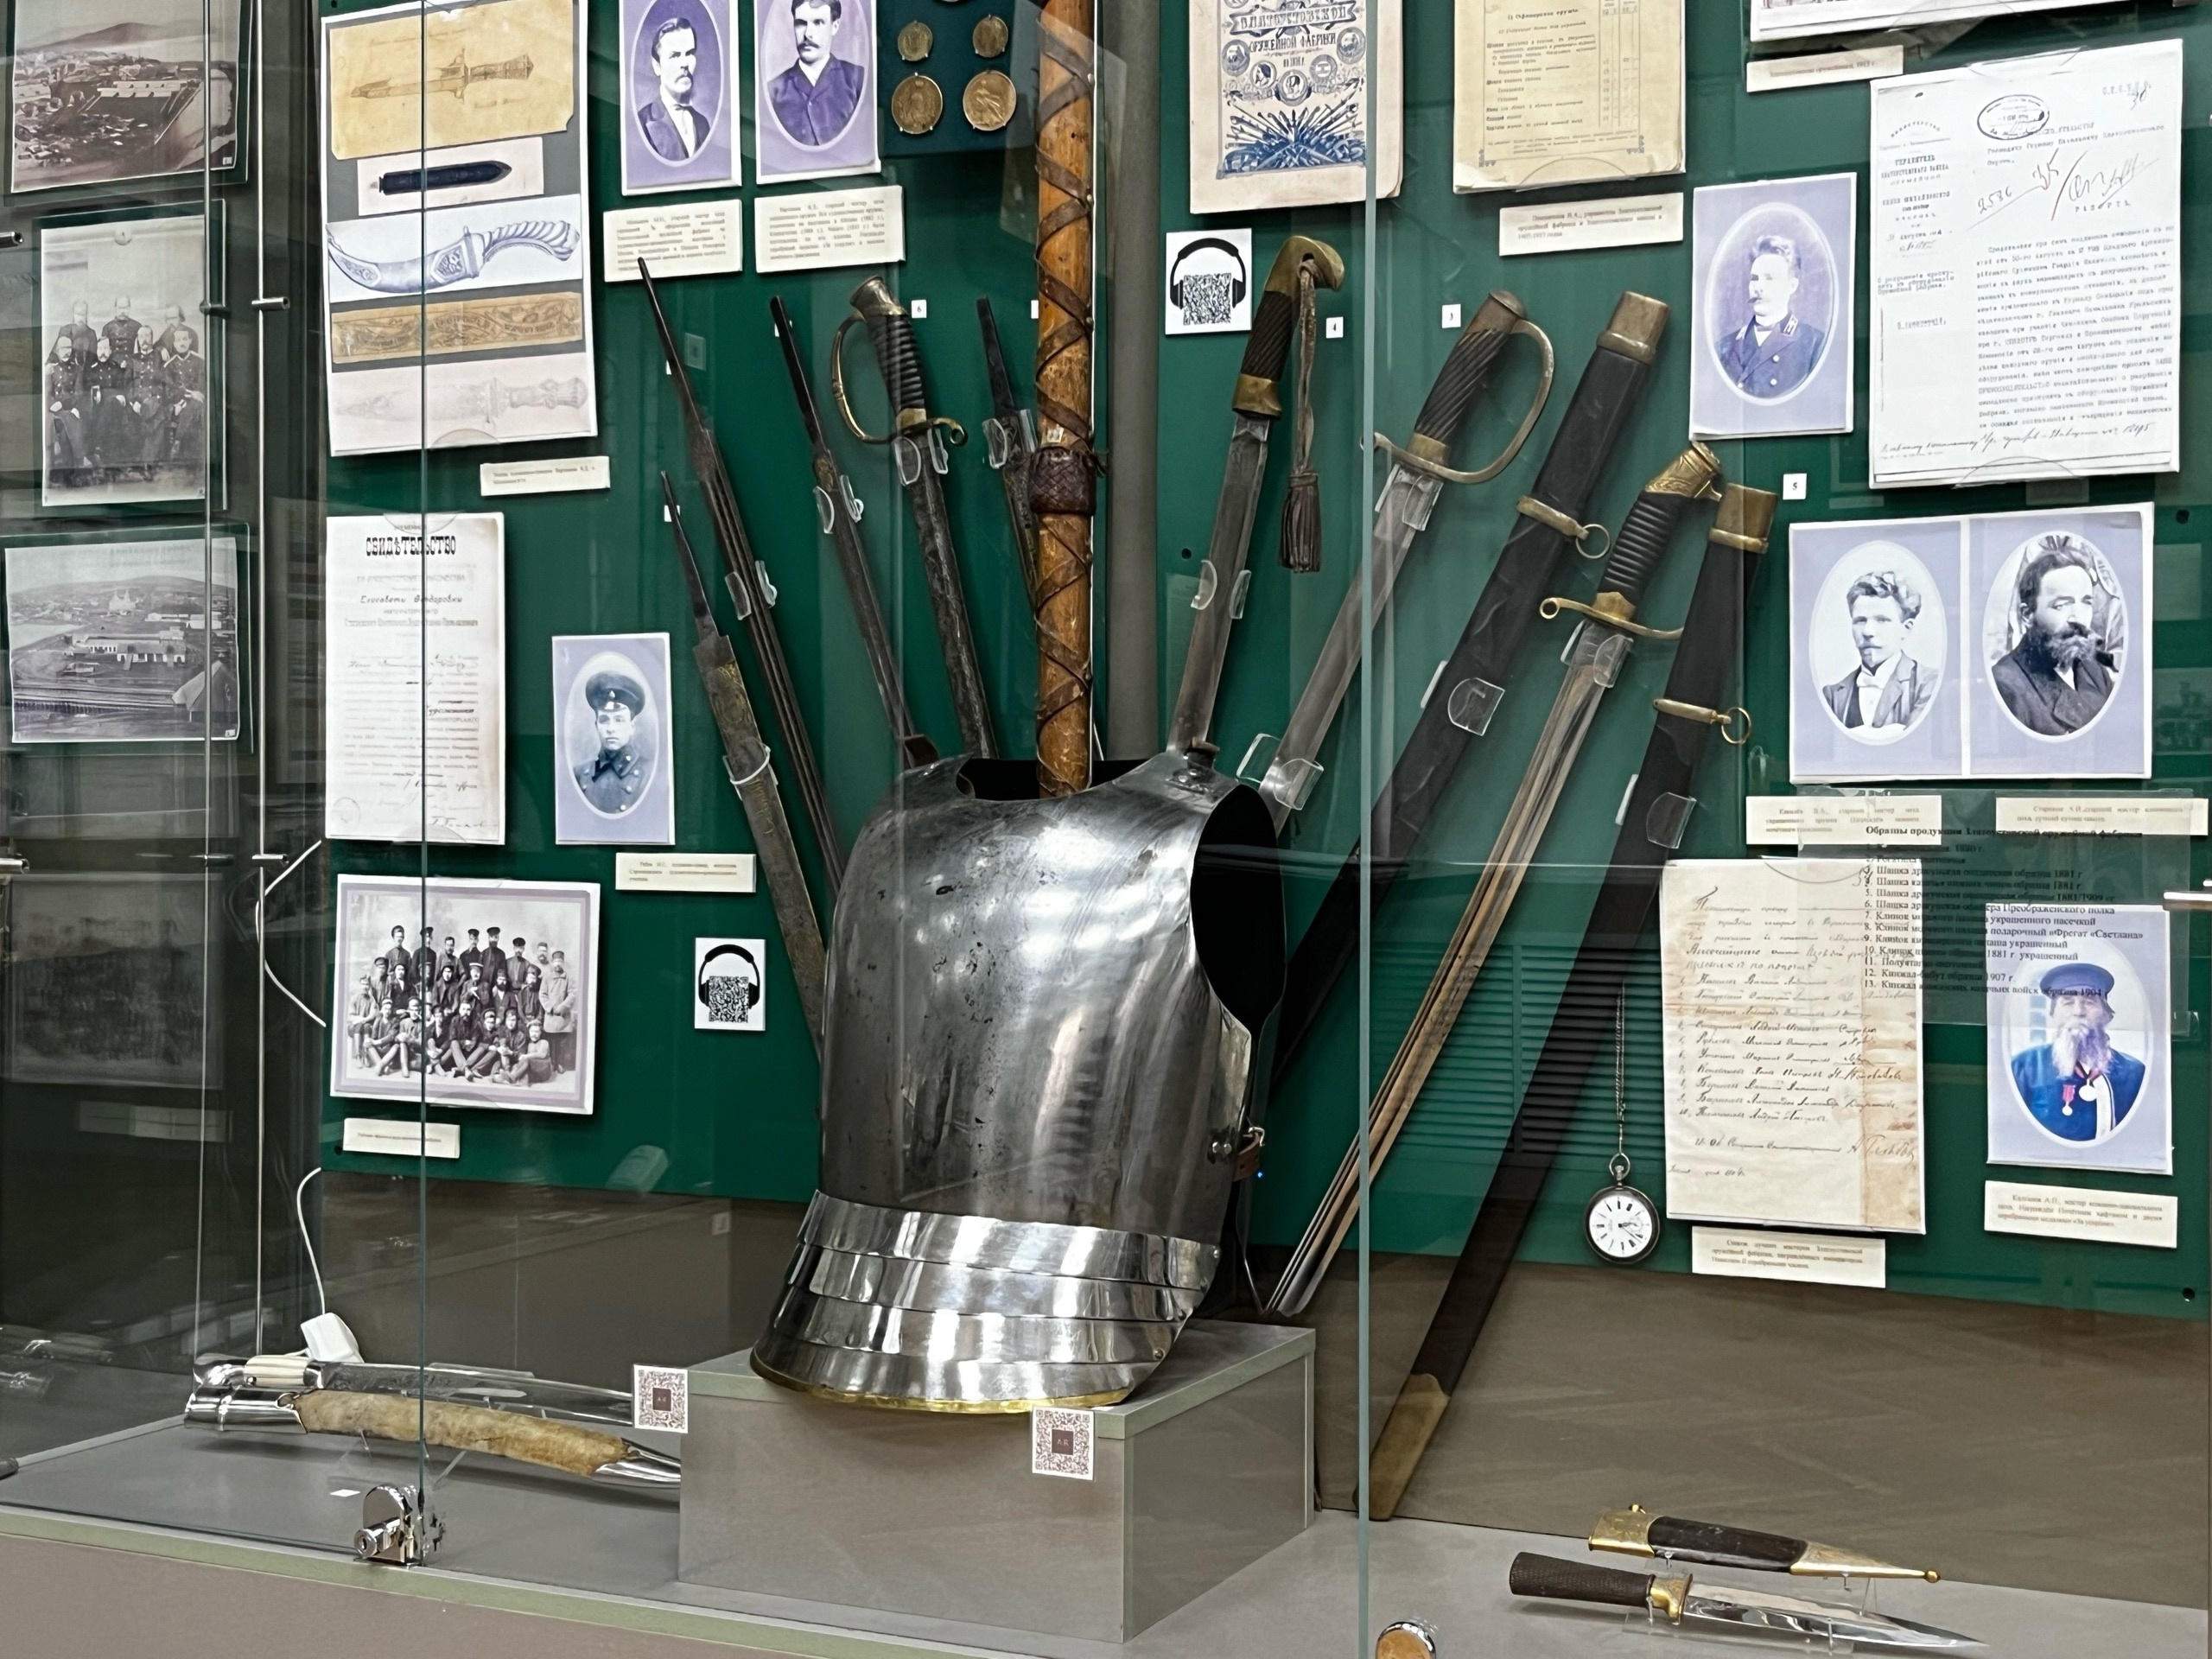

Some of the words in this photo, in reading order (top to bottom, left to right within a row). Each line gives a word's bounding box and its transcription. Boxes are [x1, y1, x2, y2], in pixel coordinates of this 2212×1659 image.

[1791, 481, 1798, 491] 5
[1877, 866, 1909, 875] Шашка
[1877, 877, 1909, 887] Шашка
[1865, 888, 1873, 898] 5.
[1876, 889, 1909, 899] Шашка
[1864, 899, 1872, 908] 6.
[1876, 899, 1909, 909] Шашка
[2088, 906, 2115, 915] полка
[1875, 912, 1910, 921] Клинок
[1990, 916, 2051, 926] украшенного
[2053, 917, 2096, 926] насечкой
[1864, 924, 1872, 932] 8.
[1875, 924, 1910, 933] Клинок
[1990, 928, 2047, 938] подарочный
[2049, 928, 2088, 938] «Фрегат
[2089, 930, 2143, 940] «Светлана»
[1875, 934, 1909, 944] Клинок
[2008, 940, 2069, 950] украшенный
[1864, 945, 1876, 954] 10.
[1878, 946, 1914, 957] Клинок
[1987, 950, 2007, 958] 1881
[2019, 951, 2079, 961] украшенный
[1864, 969, 1876, 977] 12.
[1864, 981, 1876, 989] 13.
[1881, 981, 1916, 990] Кинжал
[2012, 986, 2039, 996] войск
